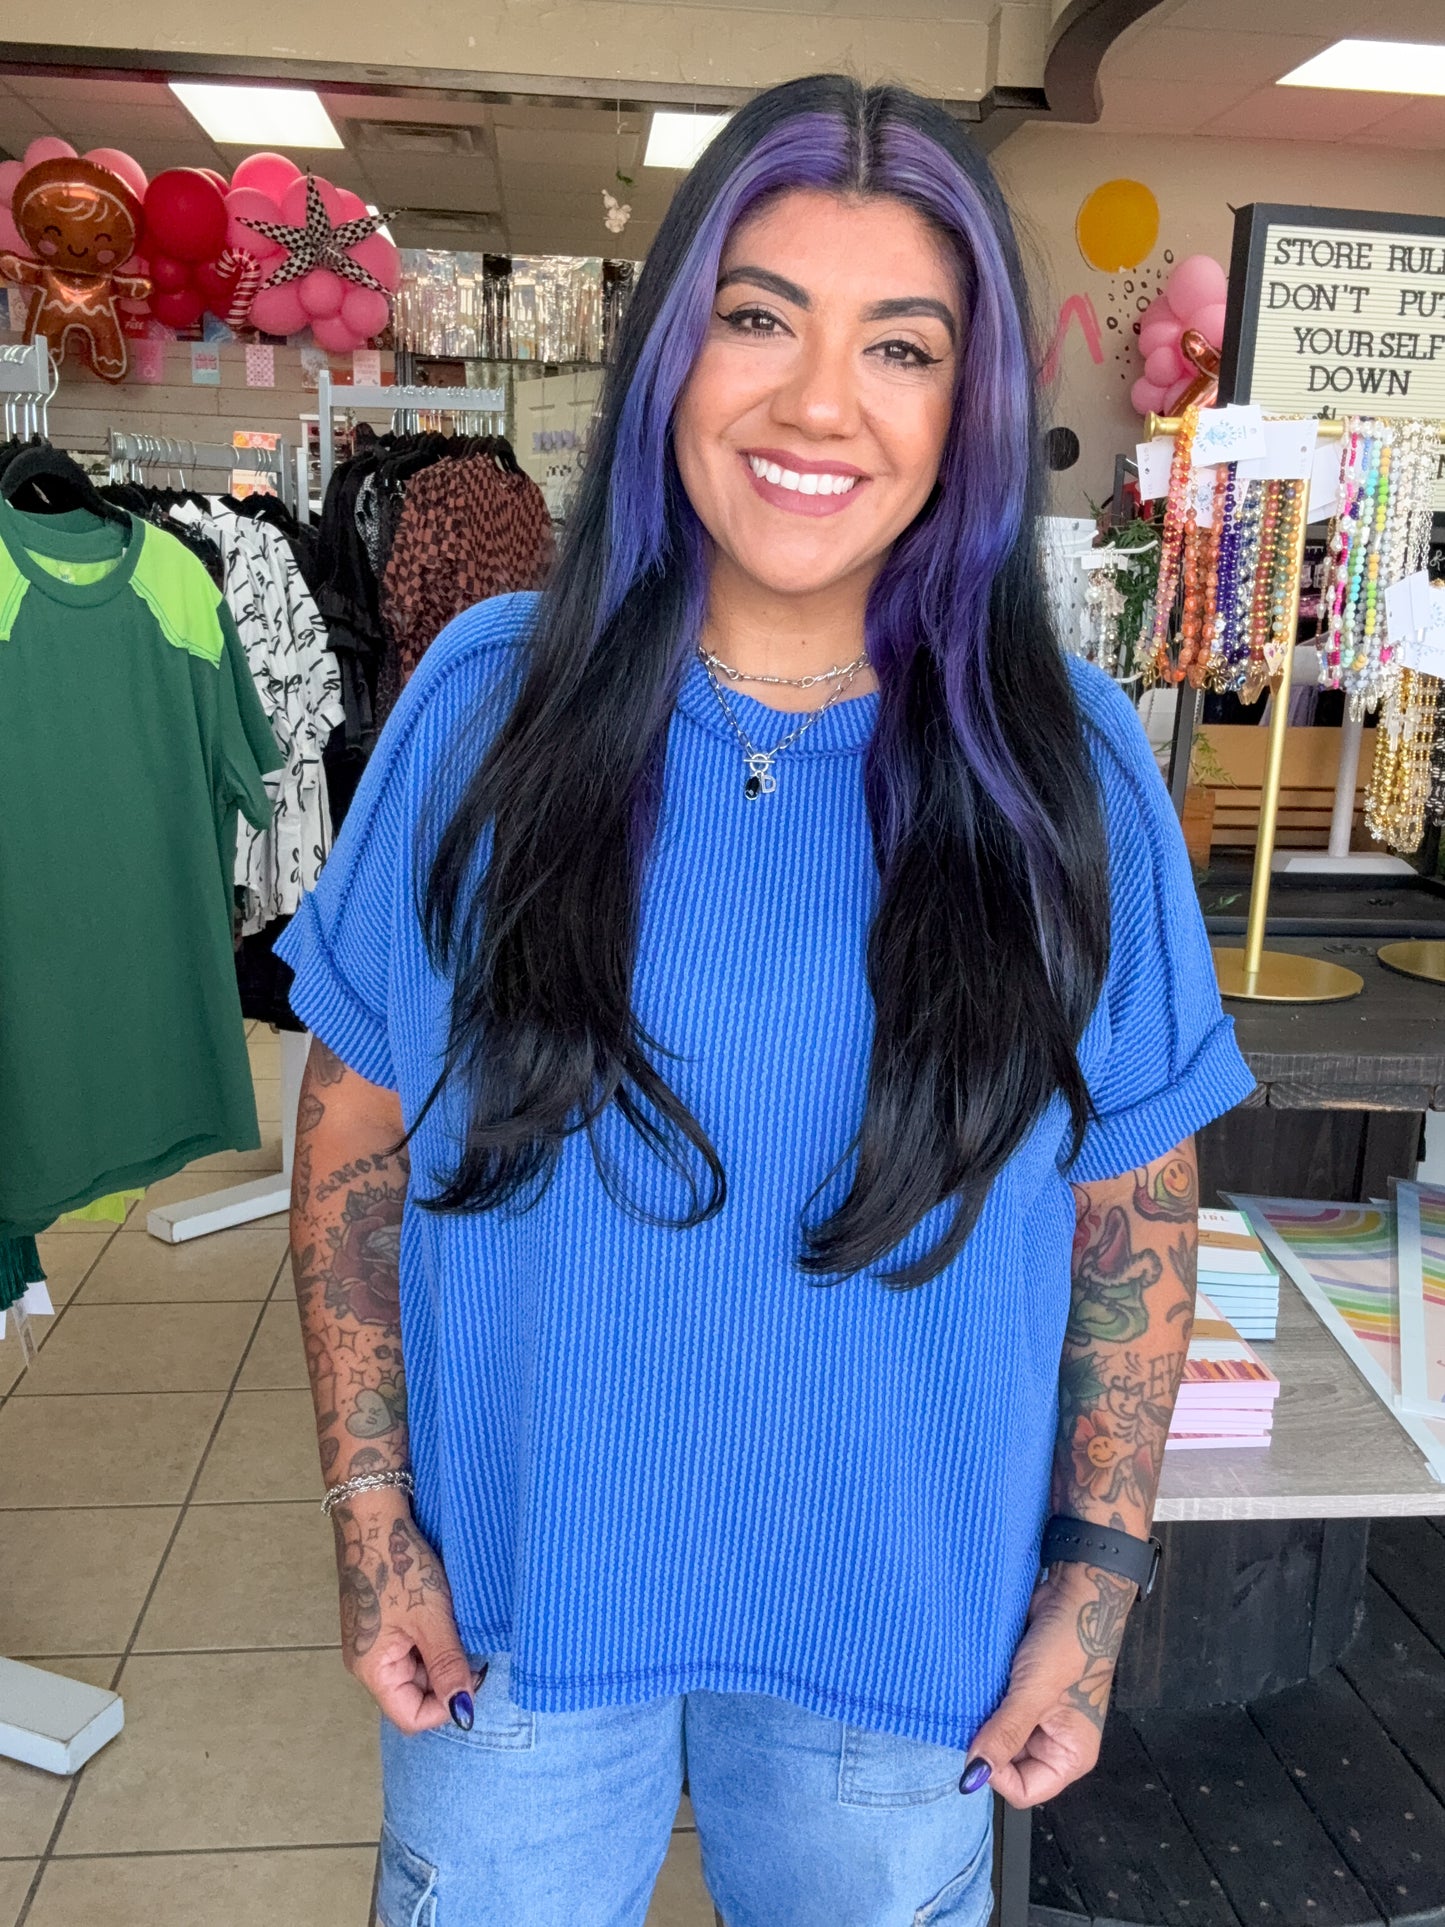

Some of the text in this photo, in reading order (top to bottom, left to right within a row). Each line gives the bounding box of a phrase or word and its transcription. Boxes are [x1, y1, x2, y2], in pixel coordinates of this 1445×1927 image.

[1274, 238, 1445, 275] STORE RUL
[1267, 282, 1370, 313] DON'T
[1293, 327, 1445, 360] YOURSELF
[1307, 365, 1412, 396] DOWN
